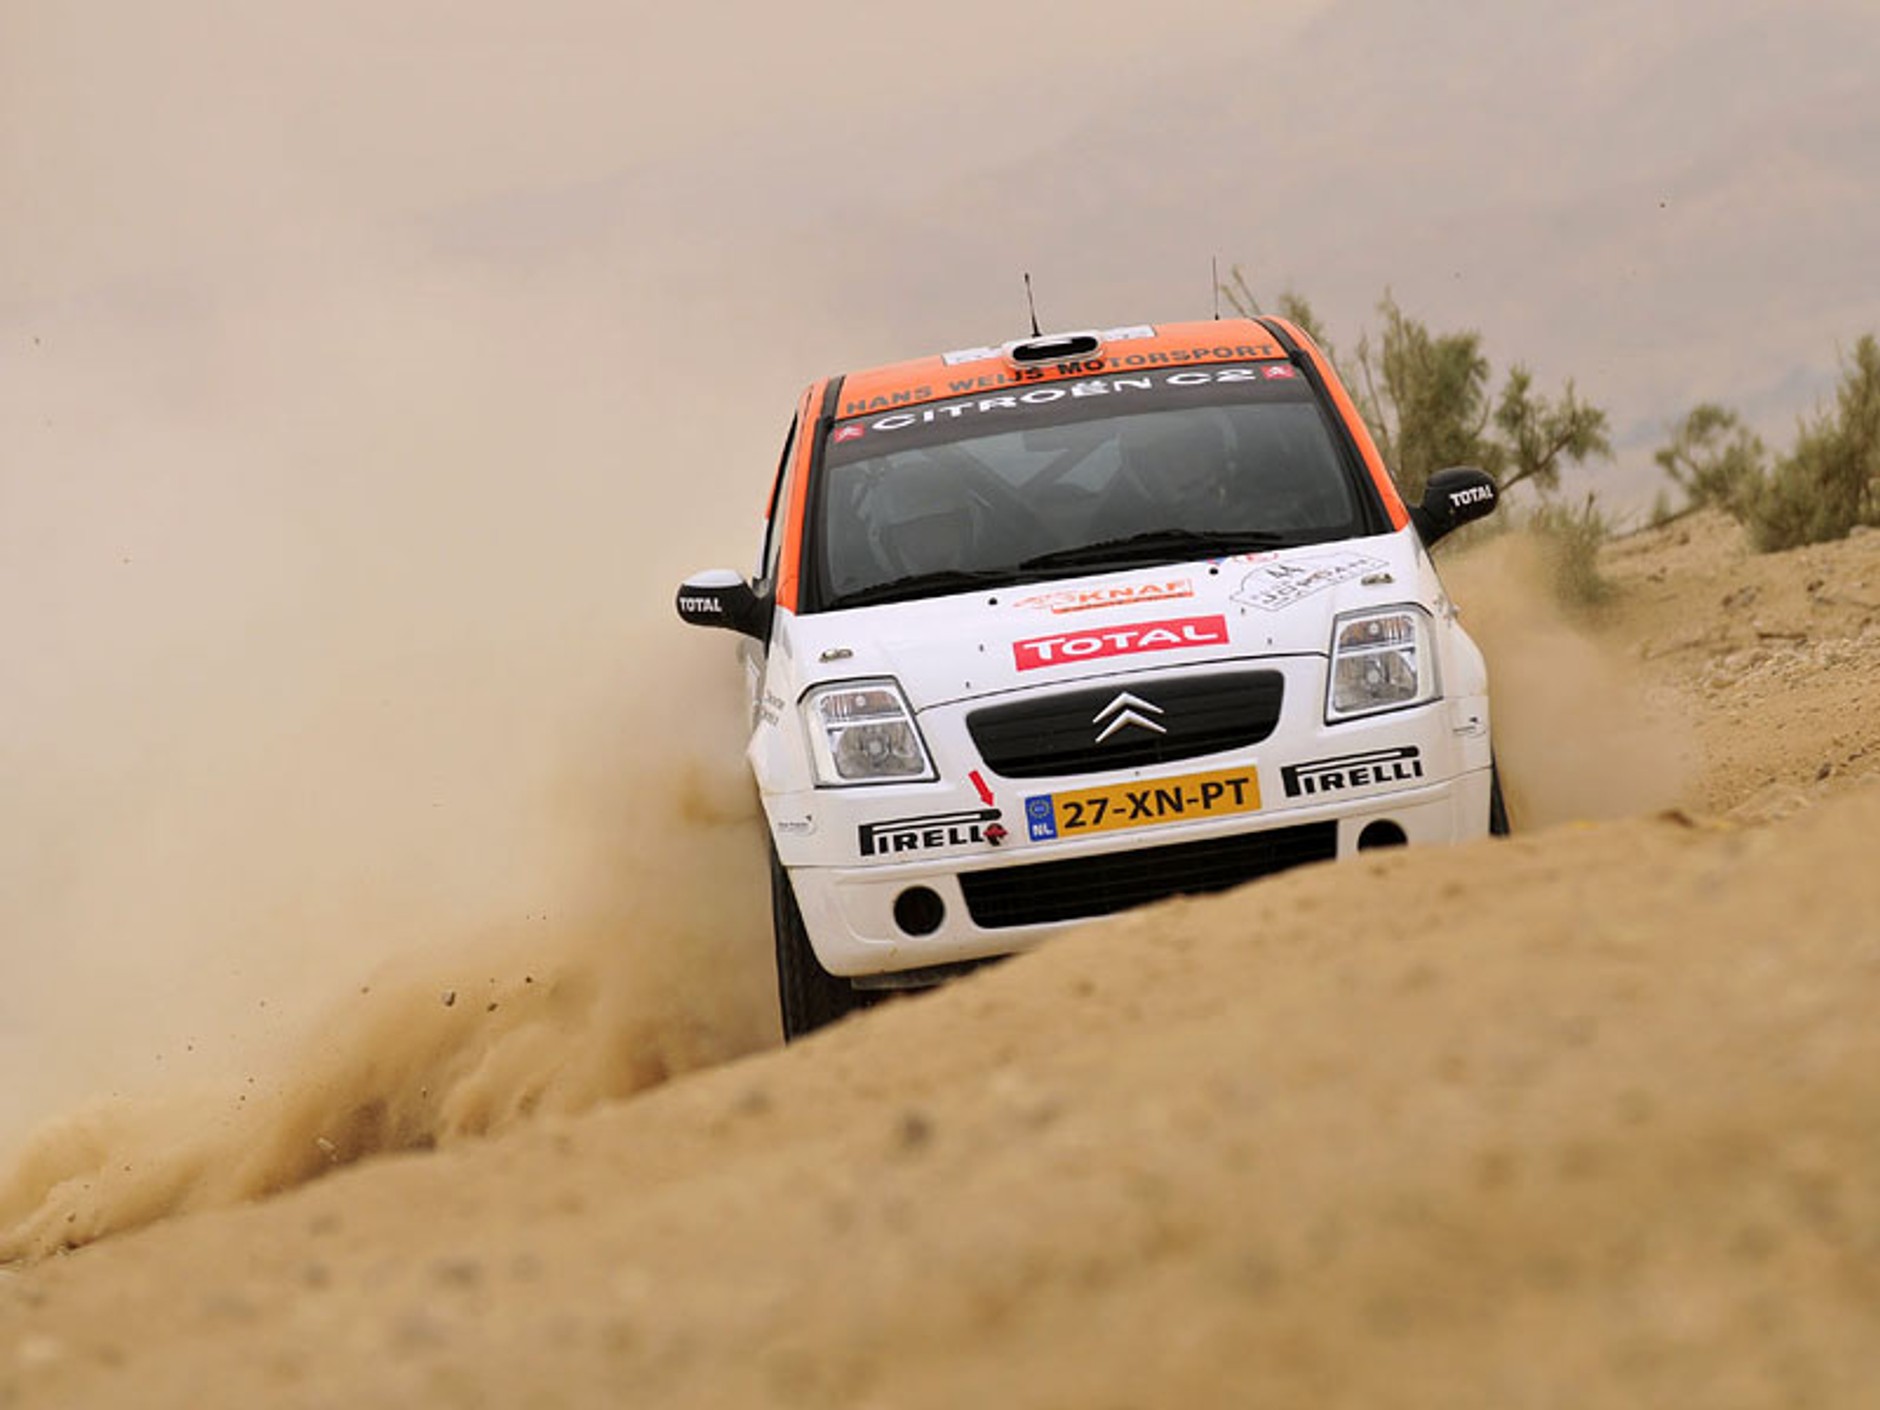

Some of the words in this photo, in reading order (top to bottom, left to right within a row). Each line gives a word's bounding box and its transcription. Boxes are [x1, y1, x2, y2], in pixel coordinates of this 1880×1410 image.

[846, 386, 932, 414] HANS
[948, 367, 1044, 392] WEIJS
[1057, 344, 1273, 375] MOTORSPORT
[1166, 368, 1256, 386] C2
[1449, 484, 1494, 507] TOTAL
[1078, 579, 1185, 602] KNAF
[679, 597, 722, 612] TOTAL
[1023, 625, 1219, 662] TOTAL
[1281, 746, 1424, 798] PIRELLI
[1062, 777, 1250, 830] 27-XN-PT
[1032, 823, 1053, 836] NL
